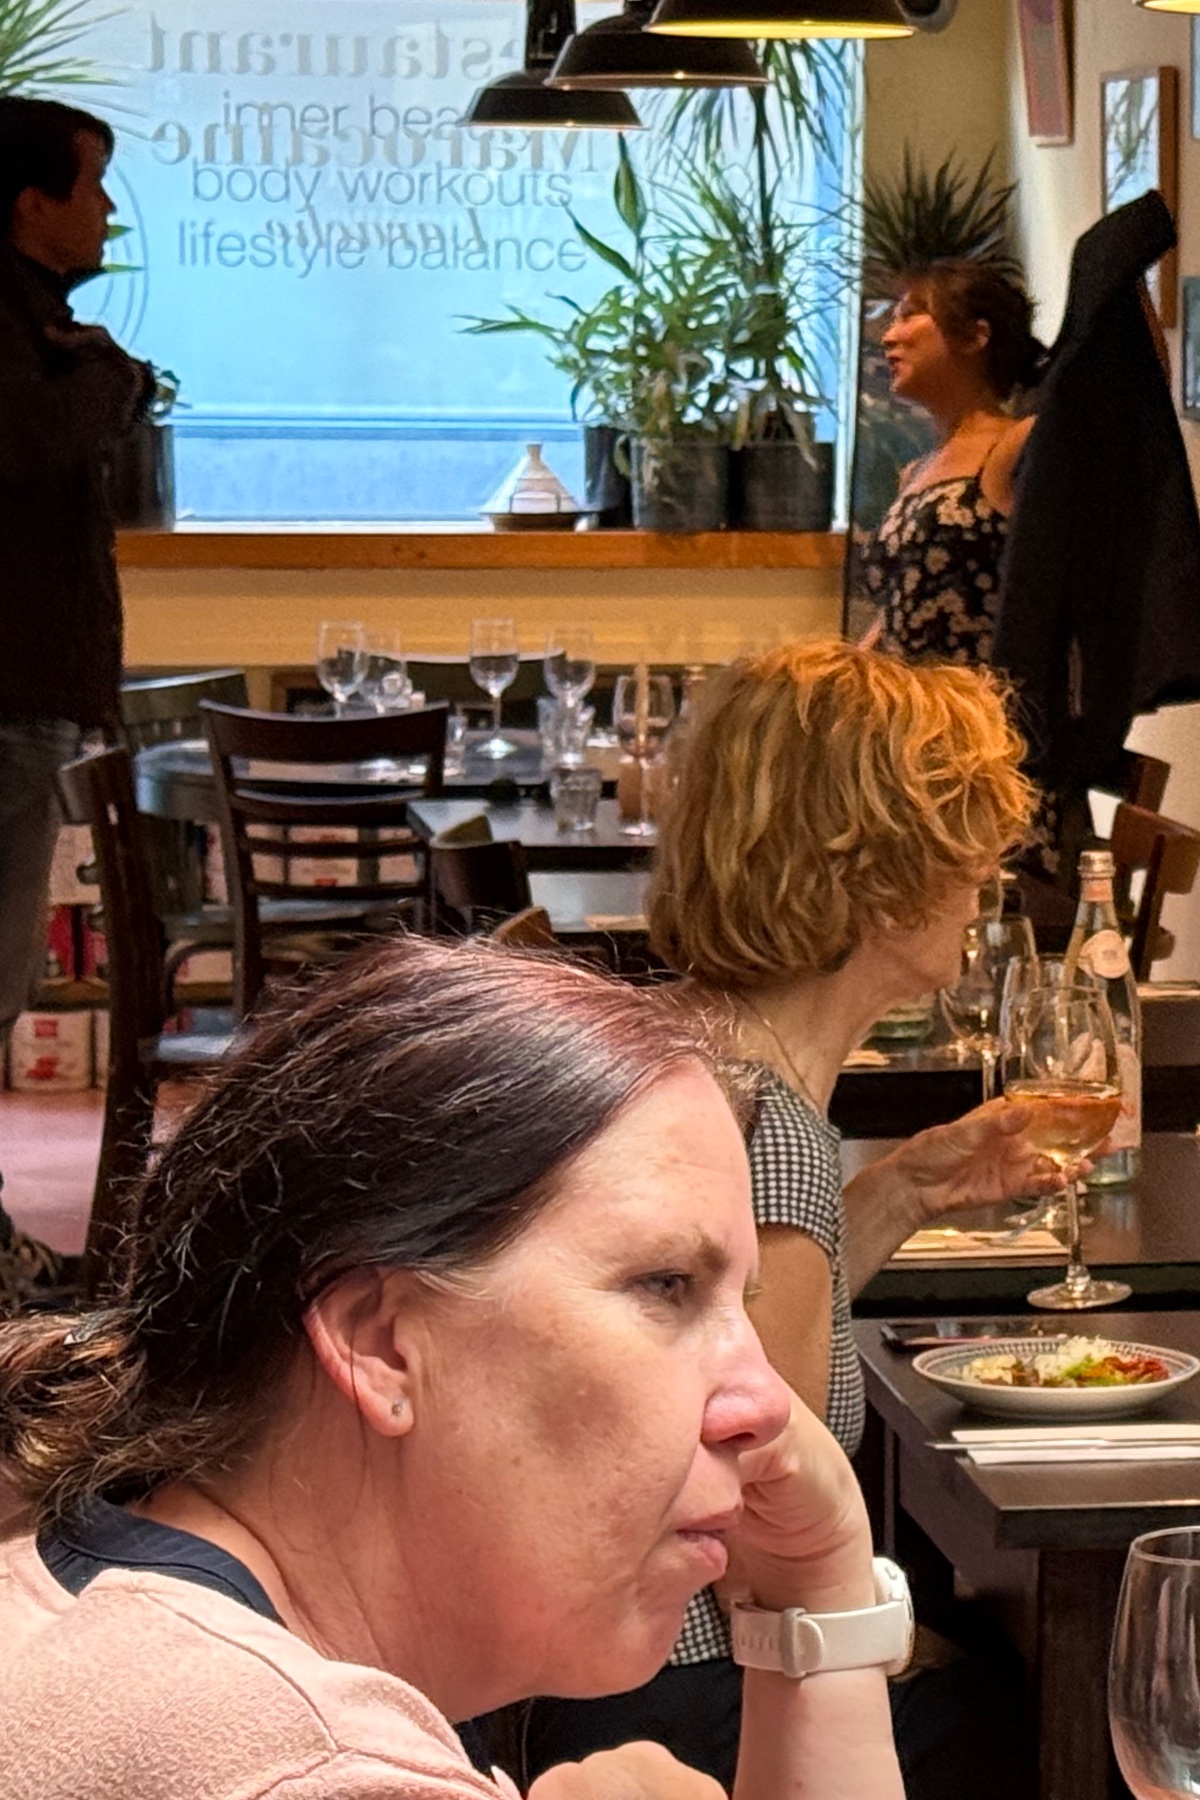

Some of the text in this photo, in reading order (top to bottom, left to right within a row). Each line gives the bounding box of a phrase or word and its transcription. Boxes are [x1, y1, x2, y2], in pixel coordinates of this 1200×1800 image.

[222, 89, 350, 141] inner
[192, 156, 573, 213] body workouts
[177, 218, 367, 279] lifestyle
[385, 221, 588, 273] balance
